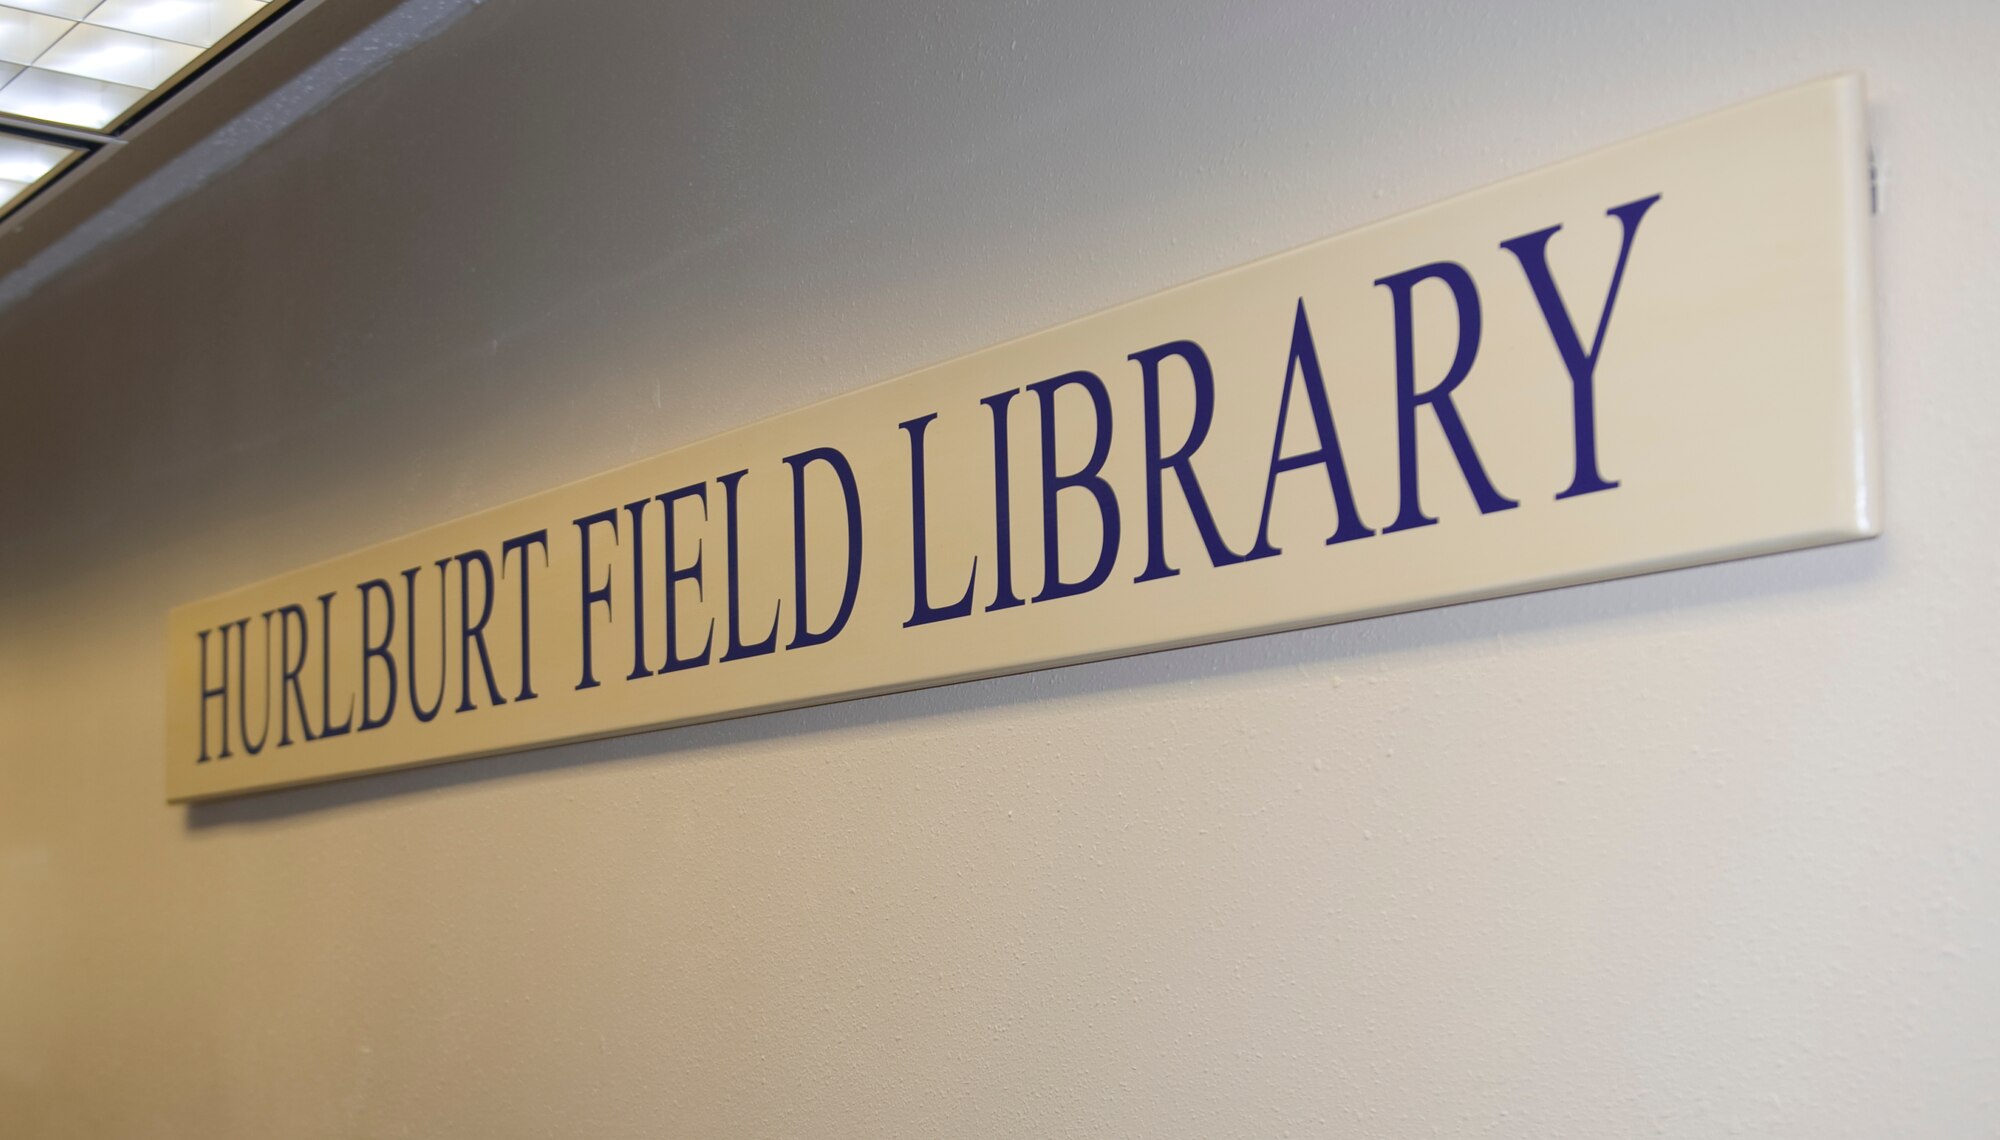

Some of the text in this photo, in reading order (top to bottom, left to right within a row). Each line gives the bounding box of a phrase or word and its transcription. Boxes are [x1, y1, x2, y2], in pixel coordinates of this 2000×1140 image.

[196, 193, 1662, 762] HURLBURT FIELD LIBRARY
